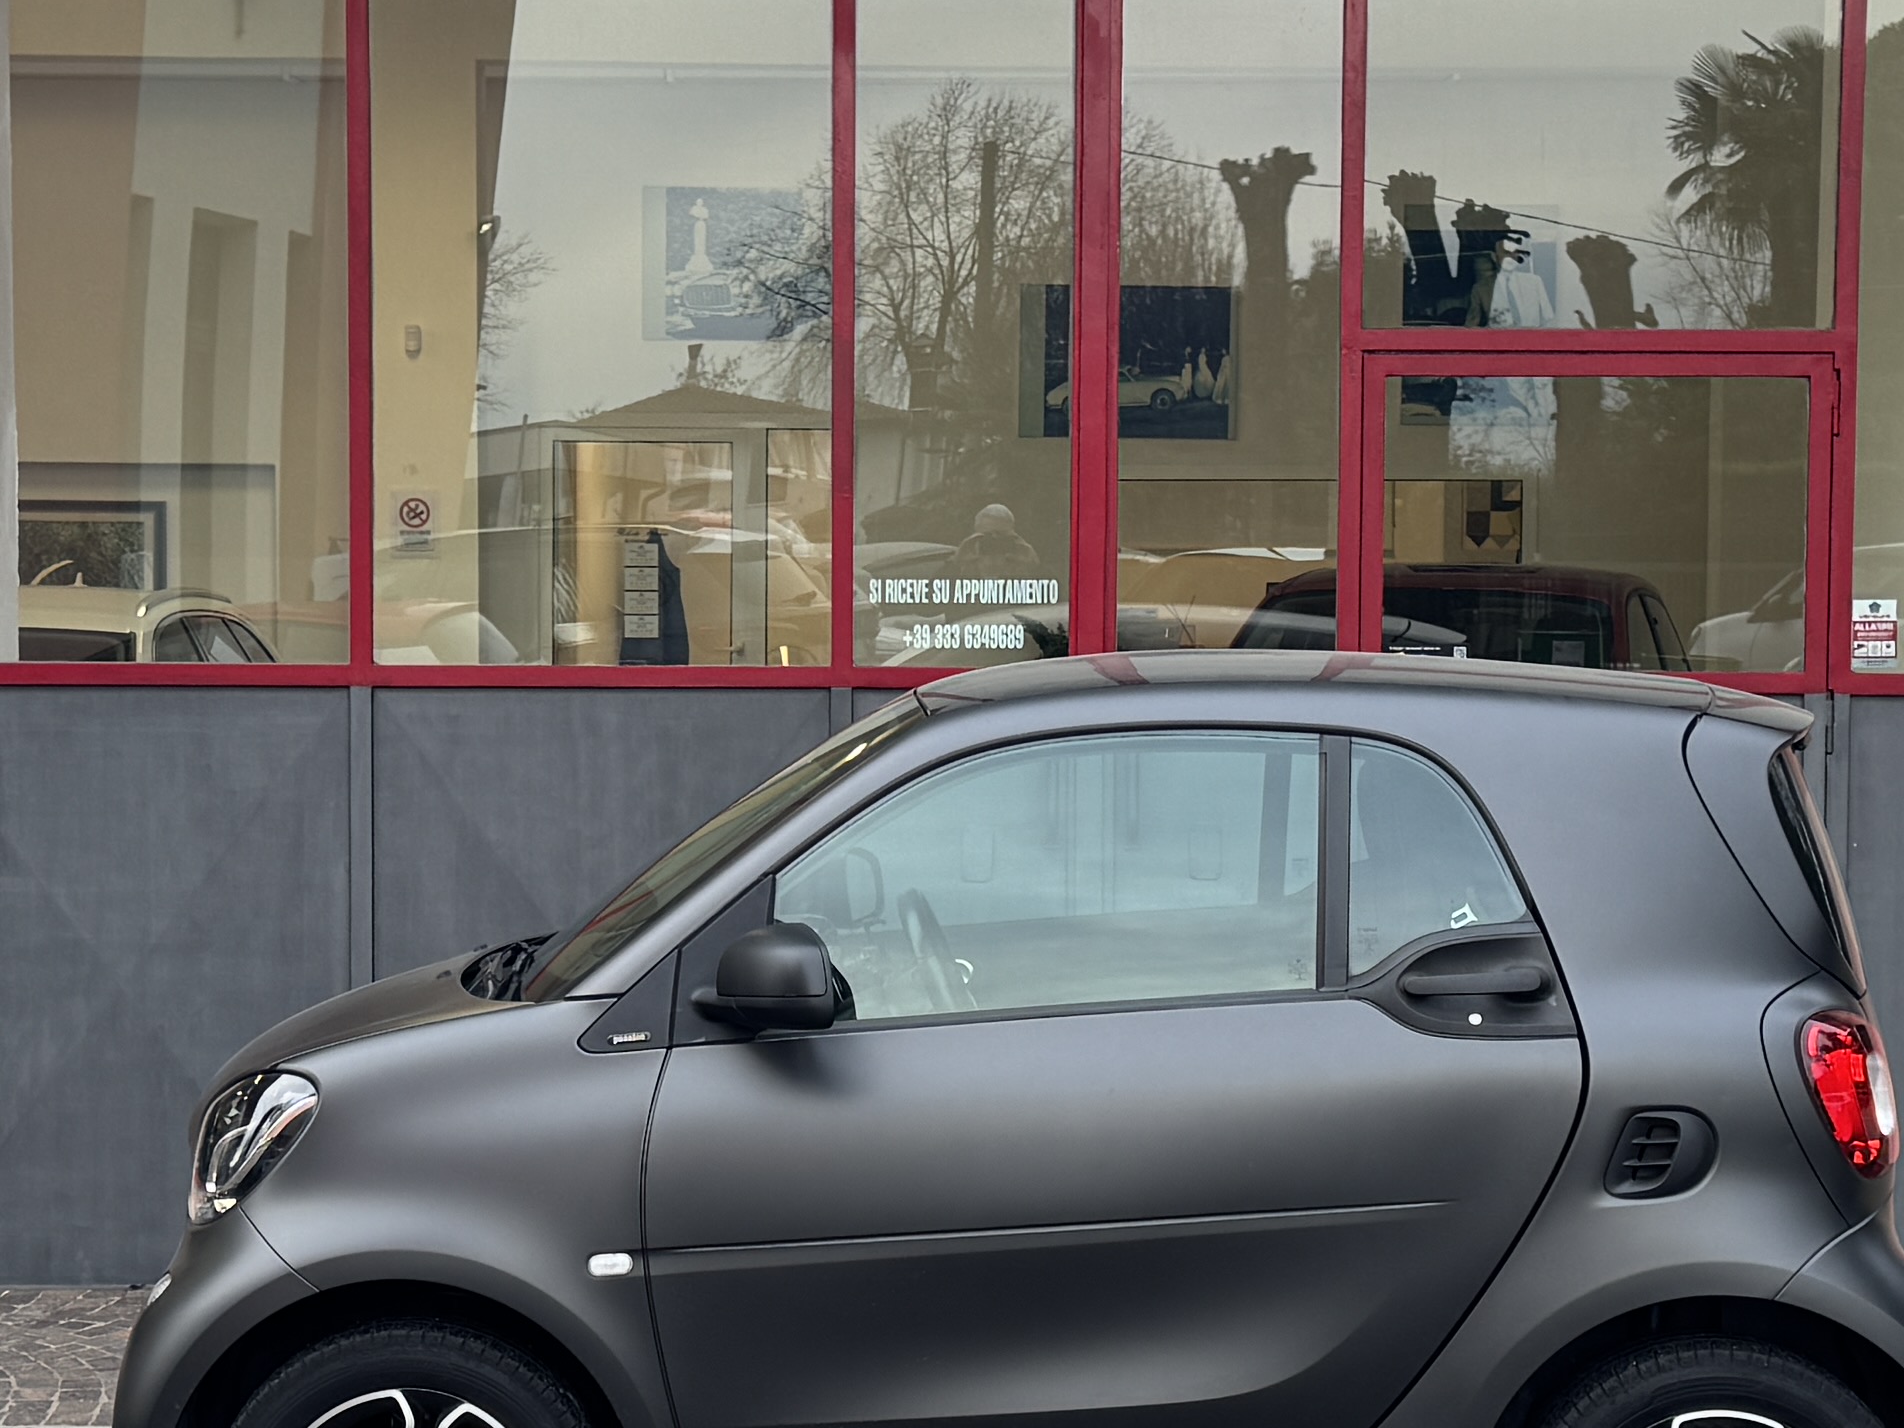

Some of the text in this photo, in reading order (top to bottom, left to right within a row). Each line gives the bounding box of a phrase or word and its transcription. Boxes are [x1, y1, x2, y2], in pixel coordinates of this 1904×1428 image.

[869, 578, 1059, 605] SI RICEVE SU APPUNTAMENTO
[902, 624, 1025, 649] +39 333 6349689
